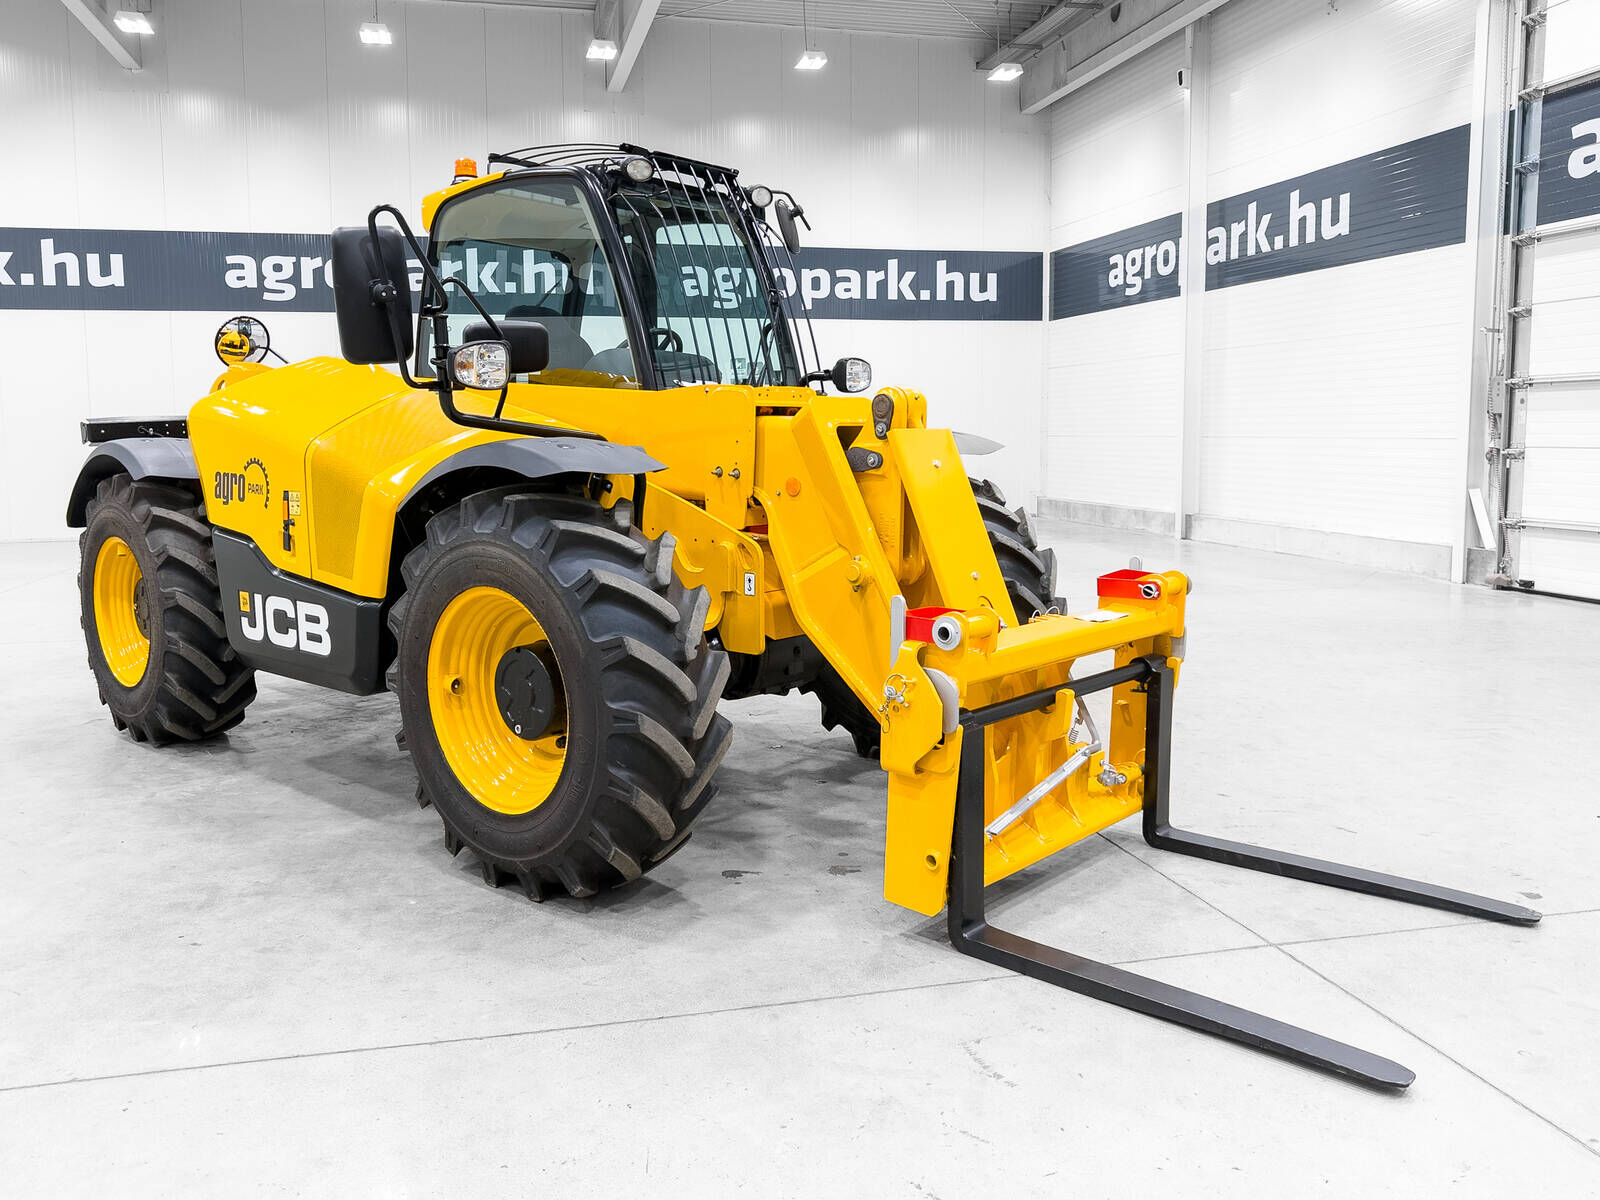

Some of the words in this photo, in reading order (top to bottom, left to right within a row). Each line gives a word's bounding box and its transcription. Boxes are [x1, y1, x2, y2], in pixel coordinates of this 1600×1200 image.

[1108, 189, 1351, 296] agroark.hu
[215, 471, 246, 505] agro
[247, 483, 264, 495] PARK
[240, 592, 331, 656] JCB
